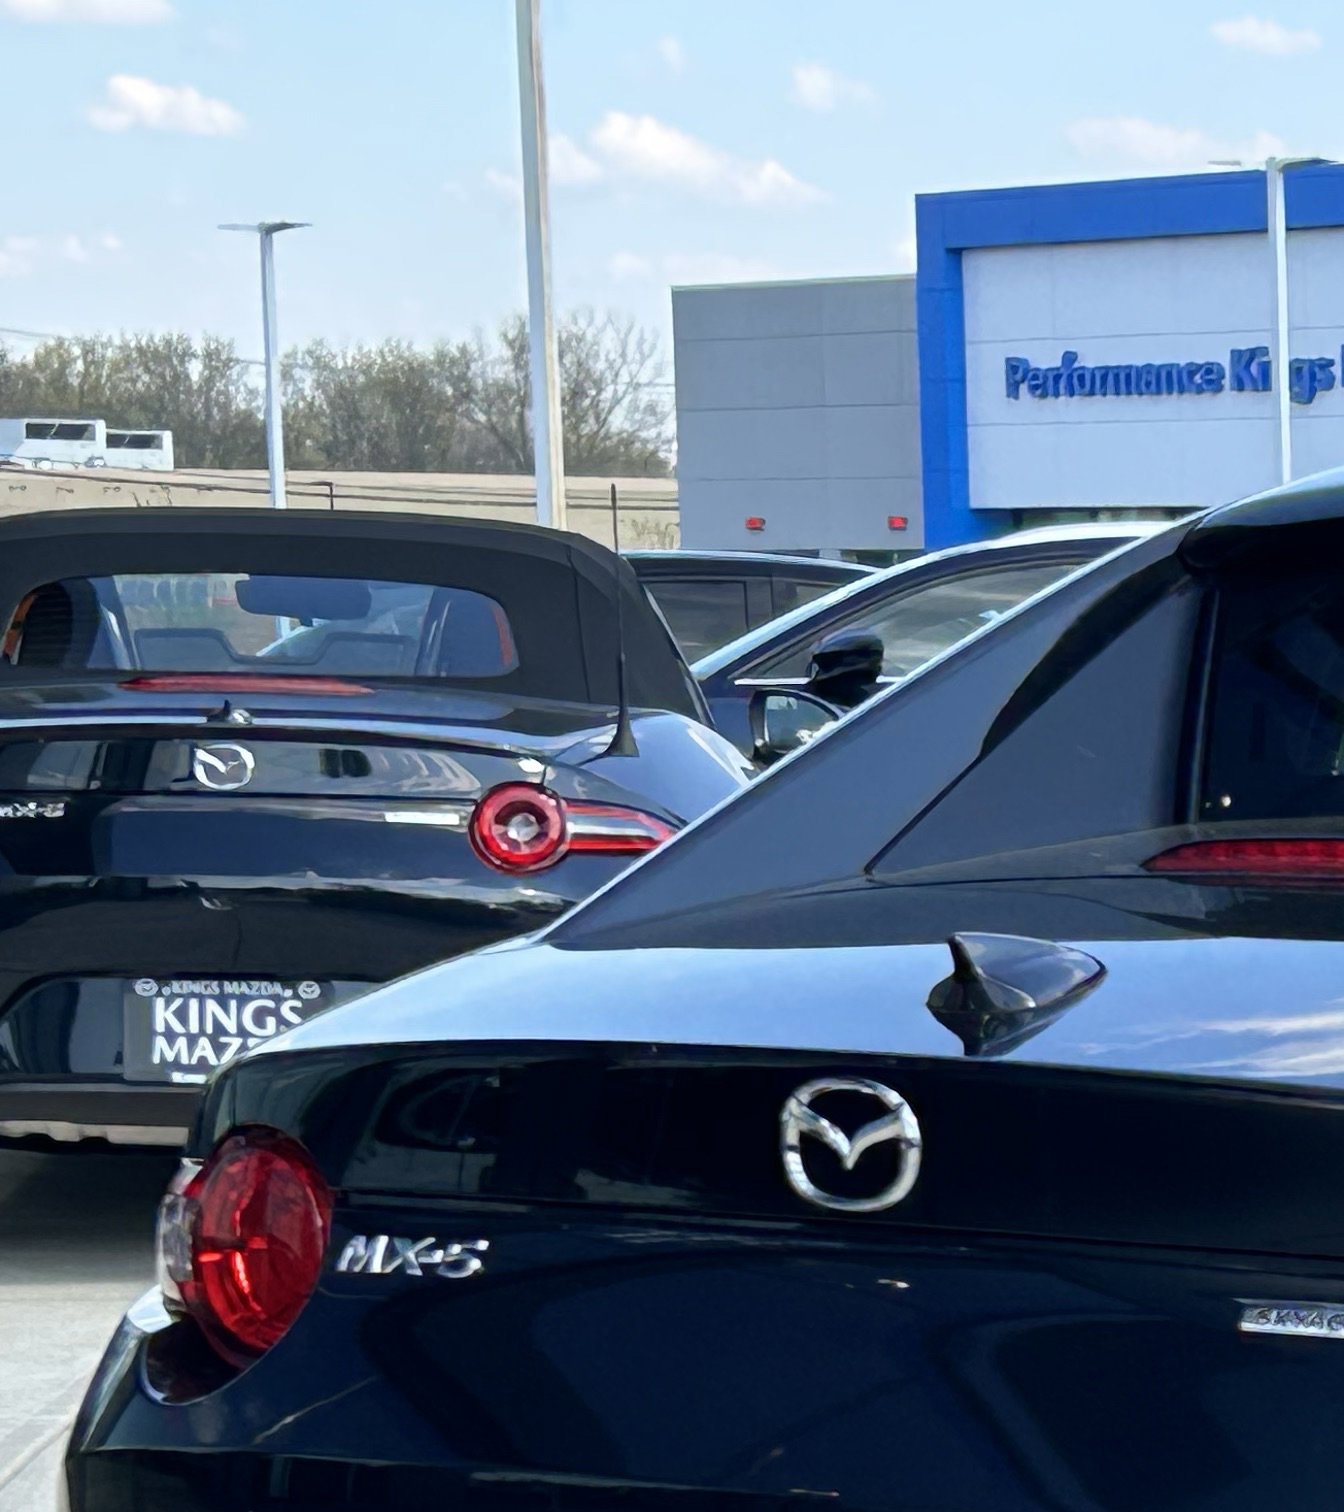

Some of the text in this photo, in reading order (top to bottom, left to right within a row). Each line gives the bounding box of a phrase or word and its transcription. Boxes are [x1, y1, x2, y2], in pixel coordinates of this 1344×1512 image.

[1005, 350, 1225, 400] Performance
[1230, 346, 1336, 405] Kigs
[223, 980, 283, 996] MAZDA
[154, 997, 303, 1037] KINGS
[152, 1035, 260, 1066] MAZ
[335, 1234, 490, 1278] MX-5
